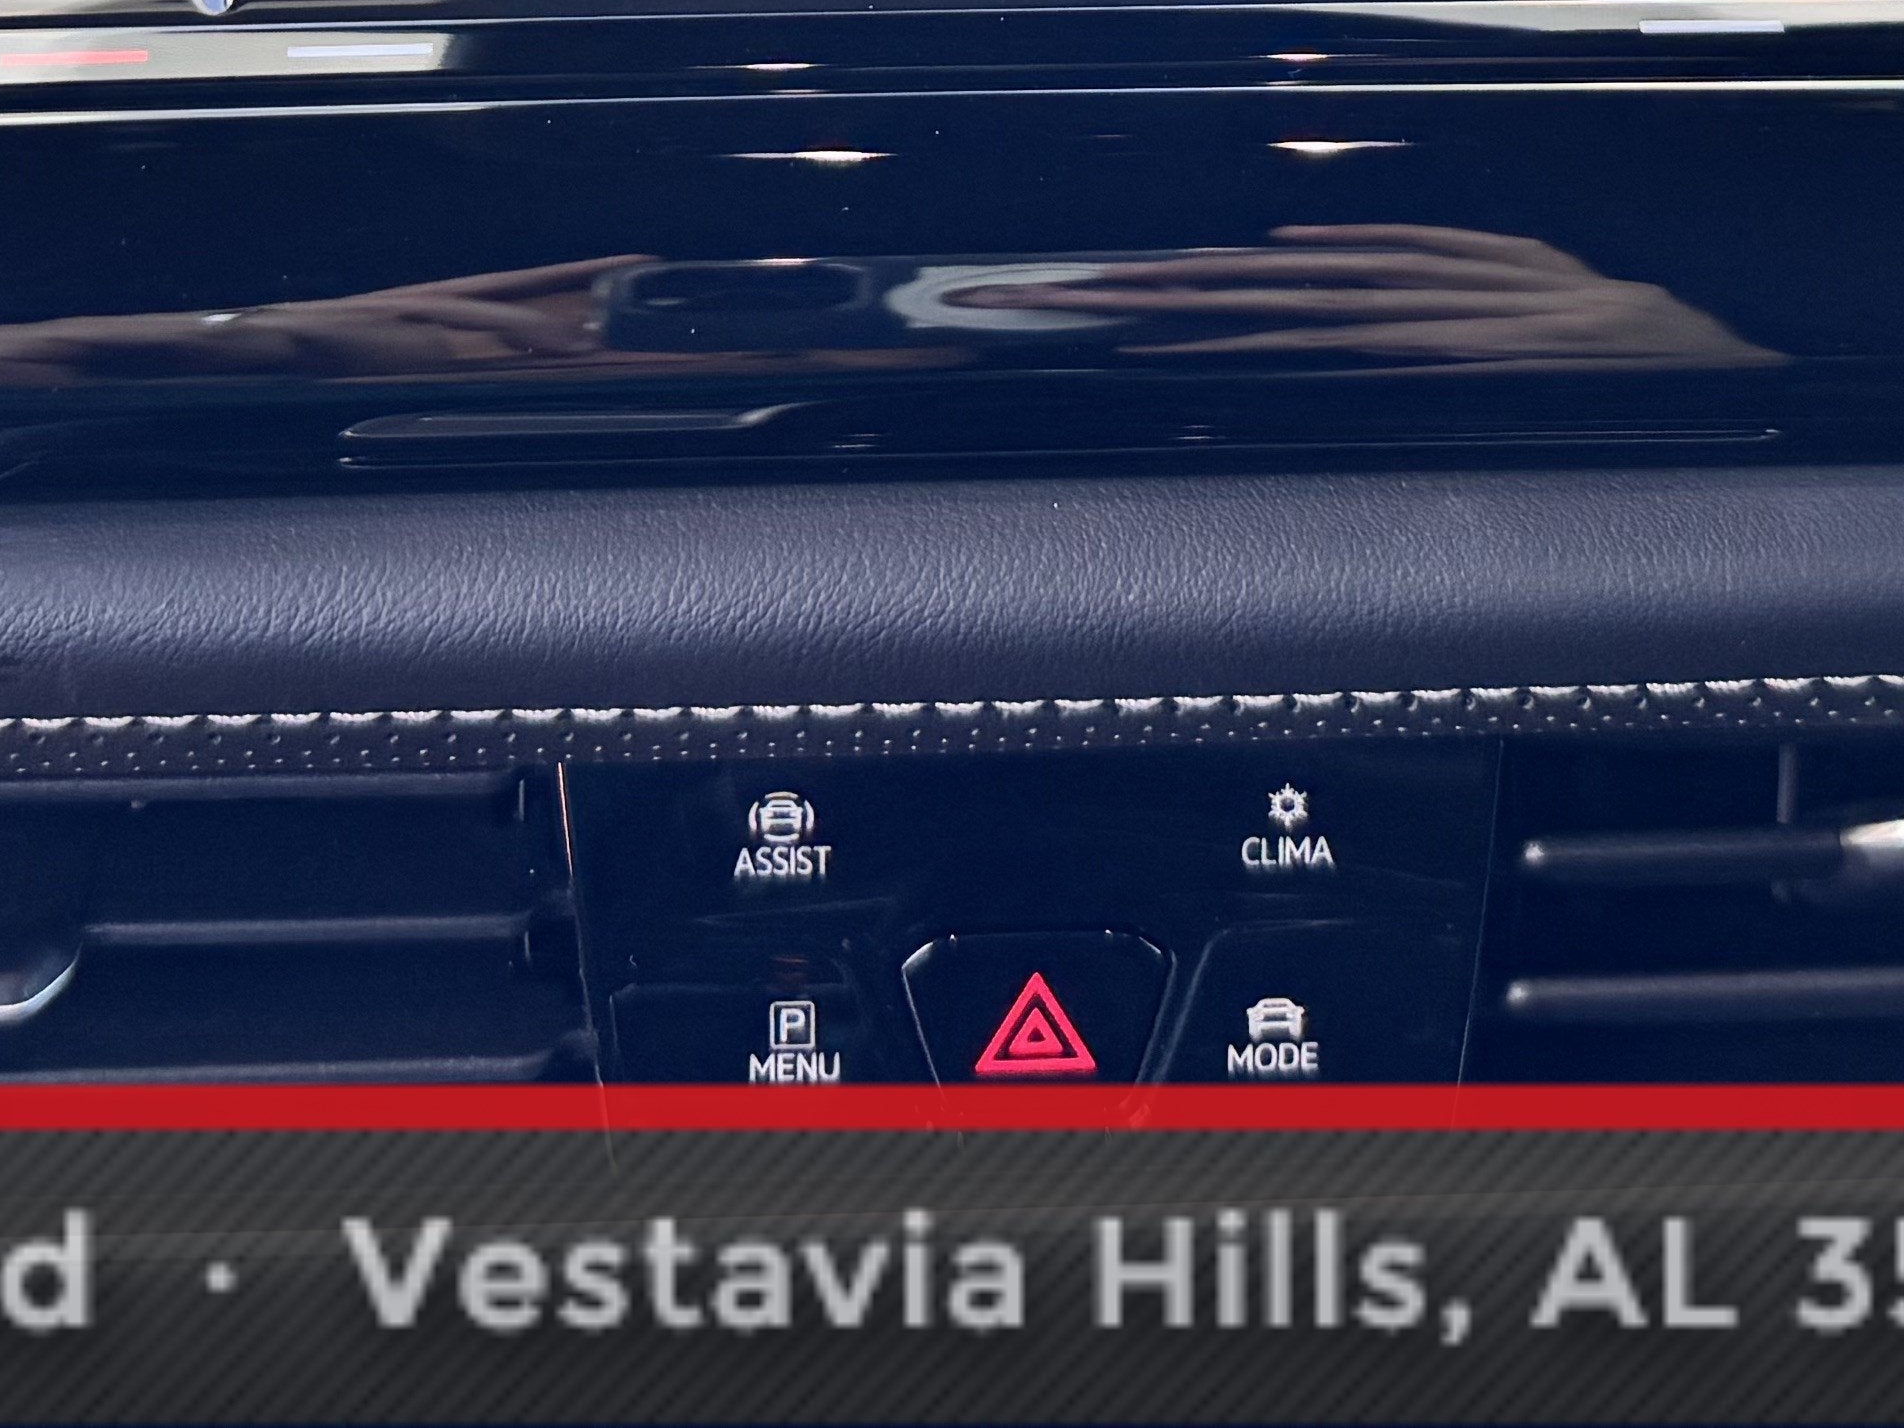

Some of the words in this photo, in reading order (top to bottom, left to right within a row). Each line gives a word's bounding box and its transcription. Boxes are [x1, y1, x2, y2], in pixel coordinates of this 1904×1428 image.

[735, 845, 830, 877] ASSIST
[1242, 837, 1332, 866] CLIMA
[750, 1053, 839, 1082] MENU
[1228, 1042, 1317, 1072] MODE
